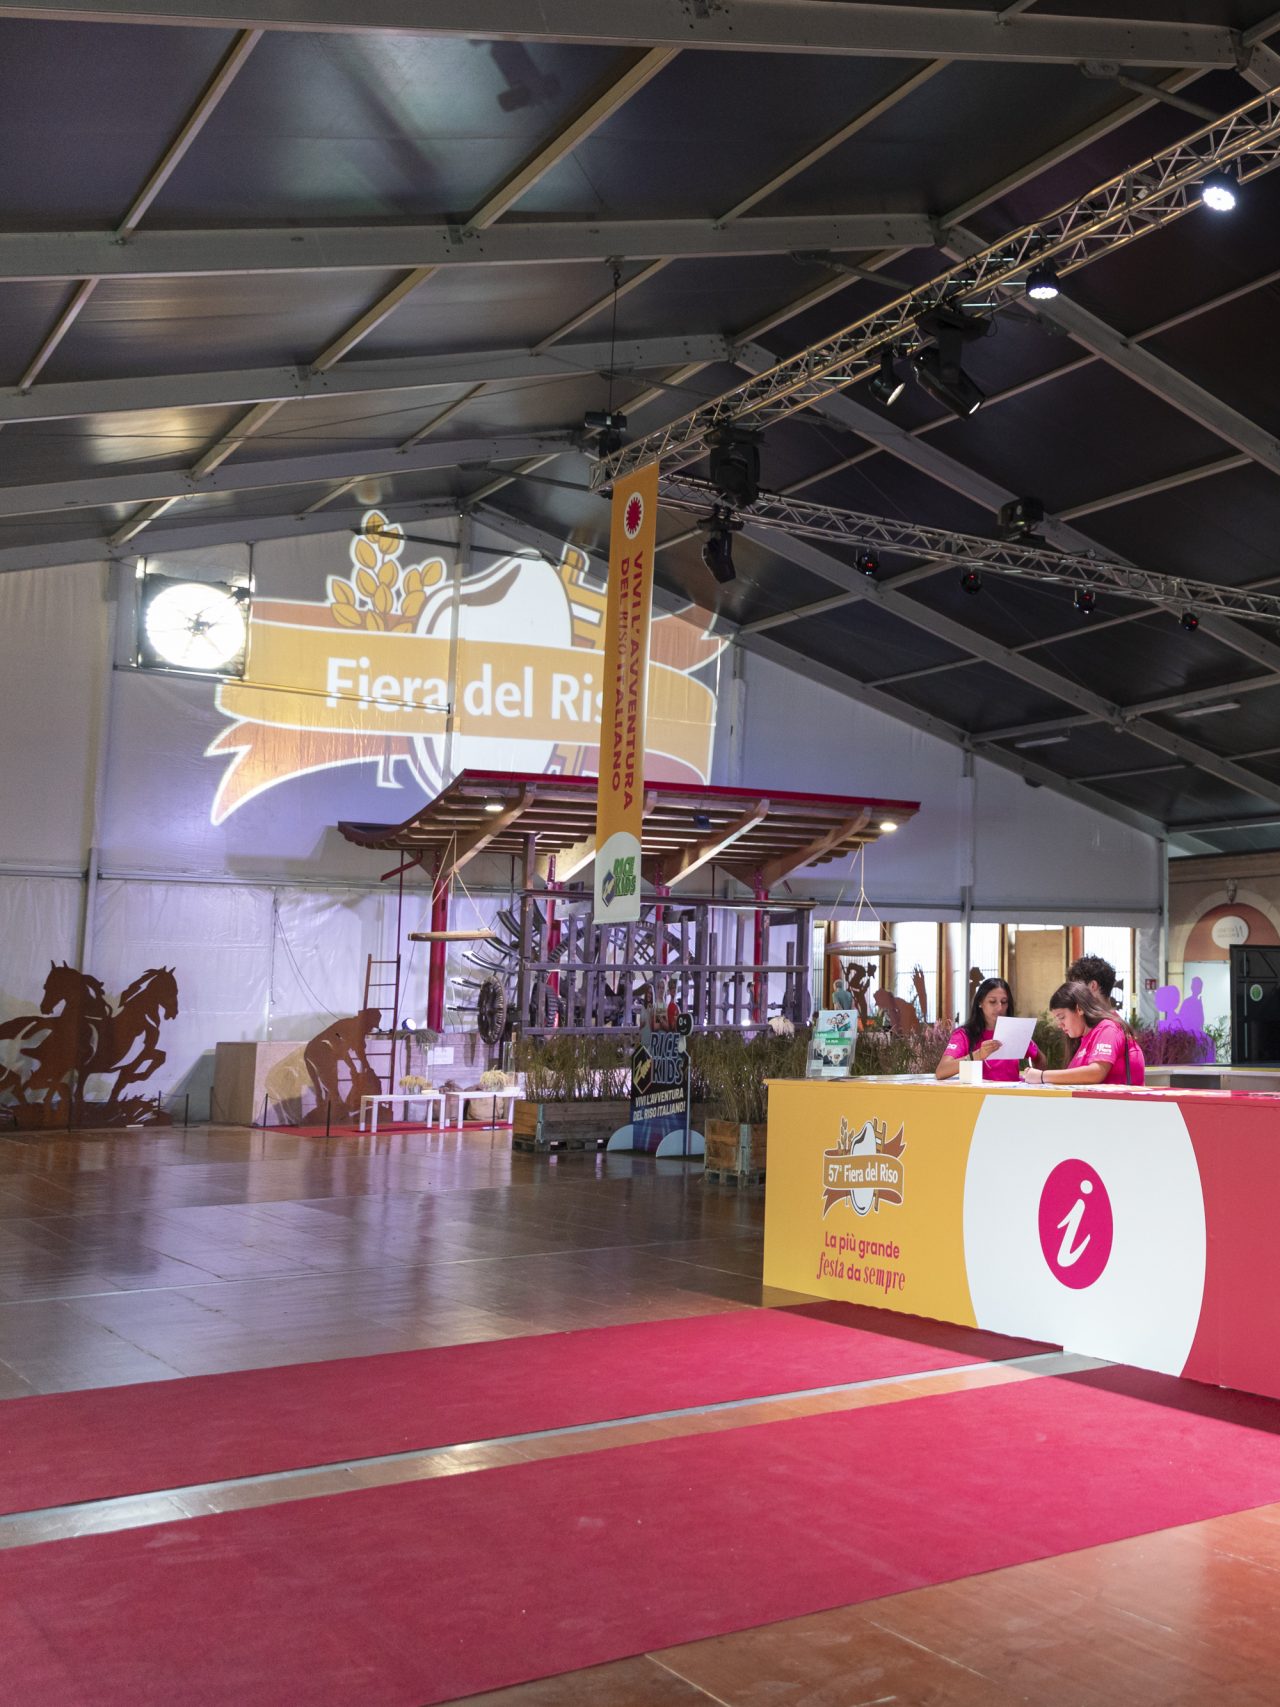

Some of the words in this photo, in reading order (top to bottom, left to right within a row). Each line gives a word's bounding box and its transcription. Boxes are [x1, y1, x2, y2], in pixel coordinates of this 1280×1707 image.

[620, 557, 630, 605] DEL
[632, 550, 643, 609] VIVI
[618, 611, 629, 655] RISO
[326, 656, 449, 713] Fiera
[463, 663, 534, 718] del
[550, 673, 603, 723] Ri
[612, 663, 625, 792] ITALIANO
[623, 614, 641, 811] L'AVVENTURA
[650, 1032, 681, 1058] RICE
[652, 1057, 684, 1085] KIDS
[828, 1164, 842, 1182] 57ª
[844, 1164, 864, 1182] Fiera
[865, 1161, 878, 1182] del
[880, 1163, 899, 1184] Riso
[825, 1231, 836, 1248] La
[839, 1233, 856, 1254] più
[858, 1241, 900, 1259] grande
[816, 1251, 845, 1280] festa
[847, 1263, 861, 1281] da
[864, 1265, 906, 1294] sempre
